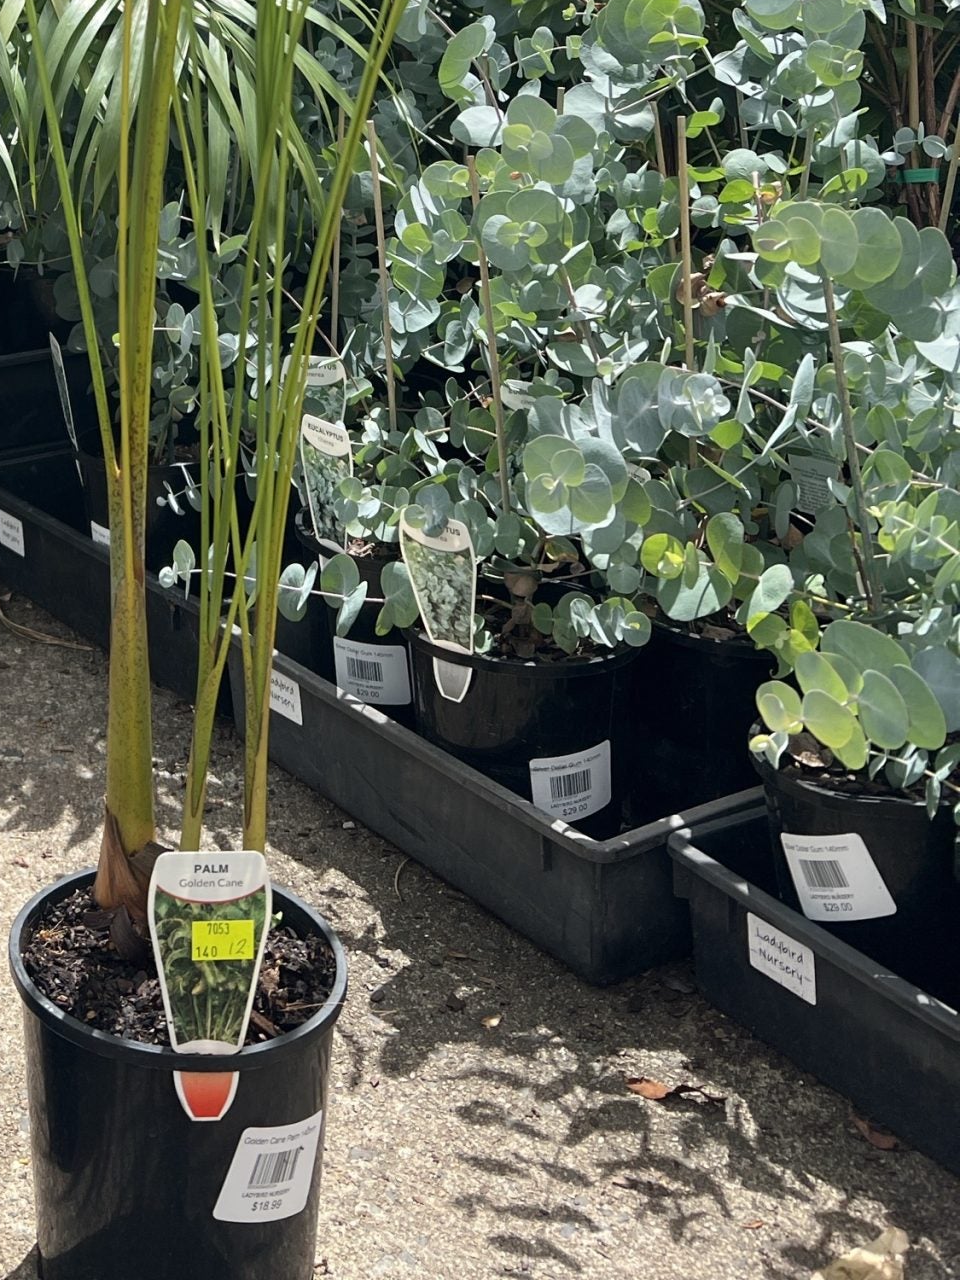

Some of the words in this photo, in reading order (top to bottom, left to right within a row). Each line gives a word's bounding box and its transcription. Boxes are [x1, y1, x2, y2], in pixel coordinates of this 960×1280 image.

[193, 864, 229, 874] PALM
[179, 878, 216, 888] Golden
[217, 878, 244, 888] Cane
[207, 922, 230, 935] 7053
[195, 945, 218, 958] 140
[228, 938, 248, 956] 12
[754, 927, 804, 965] Ladybird
[244, 1137, 269, 1145] Golden
[250, 1199, 282, 1212] $18.99
